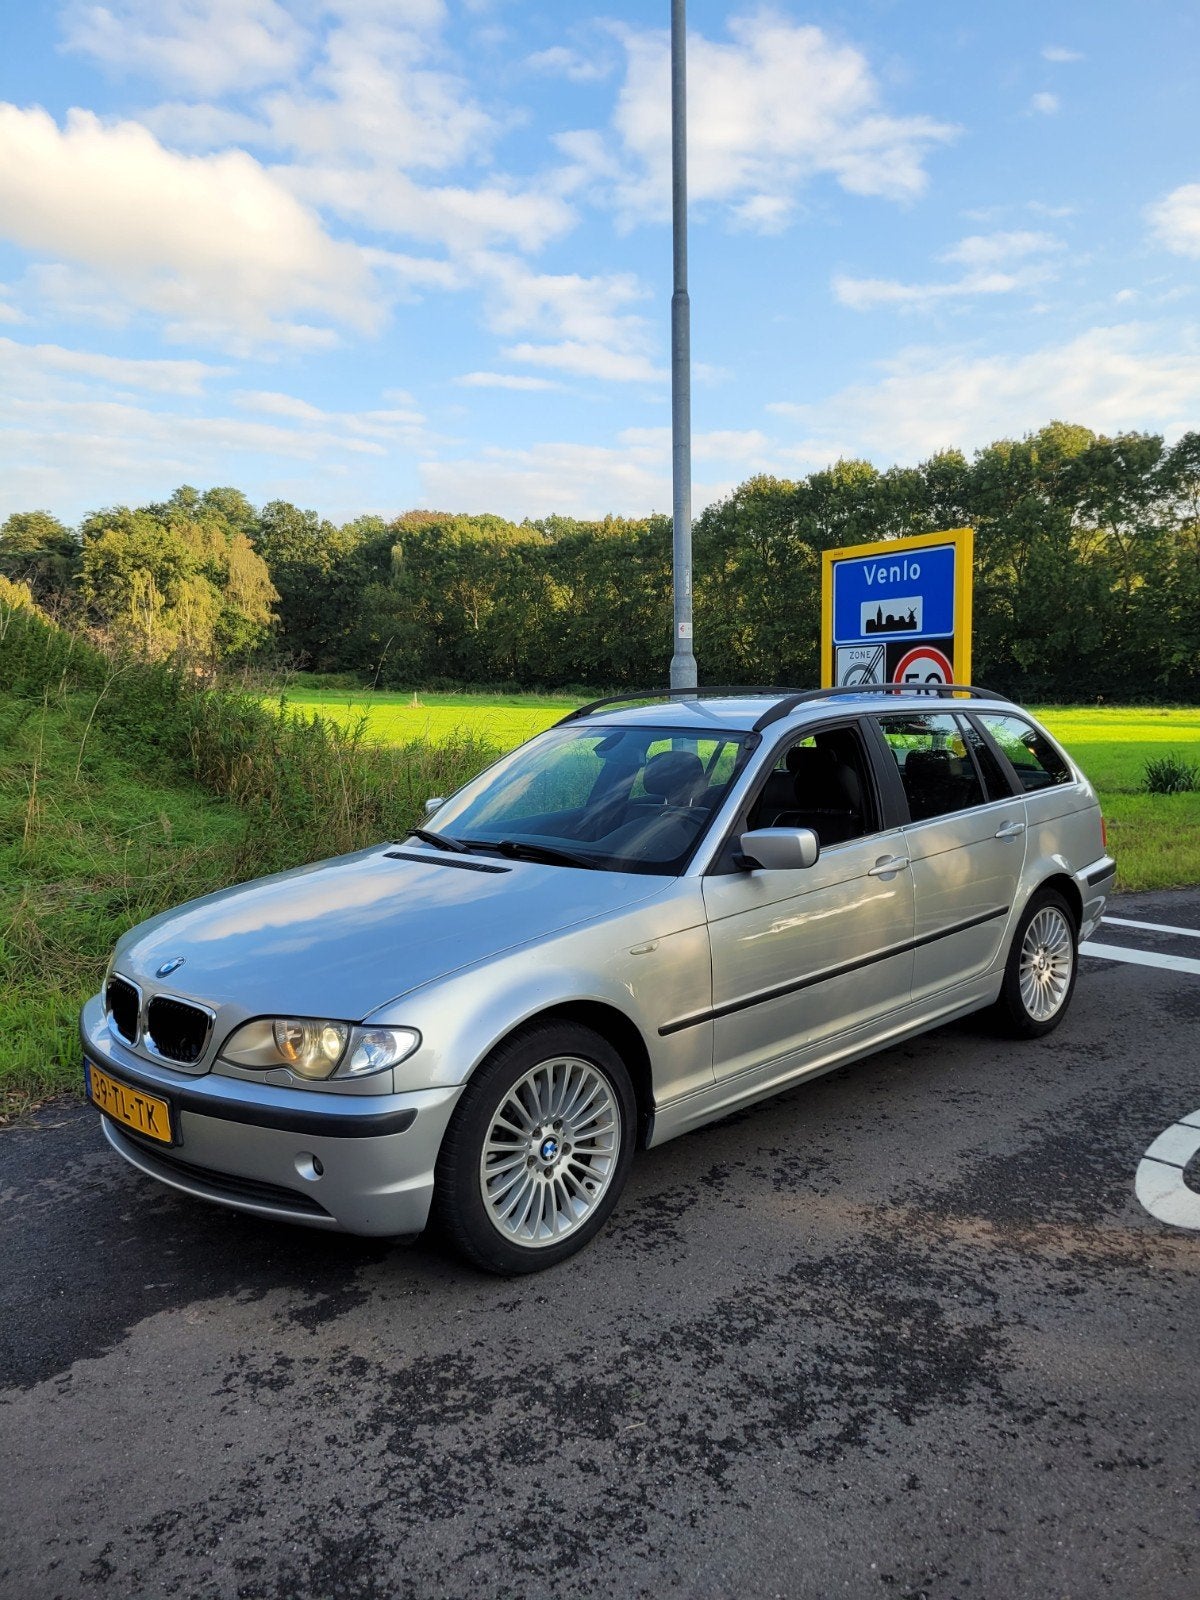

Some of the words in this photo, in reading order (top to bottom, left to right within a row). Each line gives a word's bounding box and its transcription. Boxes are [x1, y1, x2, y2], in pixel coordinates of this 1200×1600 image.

[863, 559, 921, 585] Venlo
[849, 650, 871, 660] ZONE
[94, 1073, 159, 1134] 39-TL-TK
